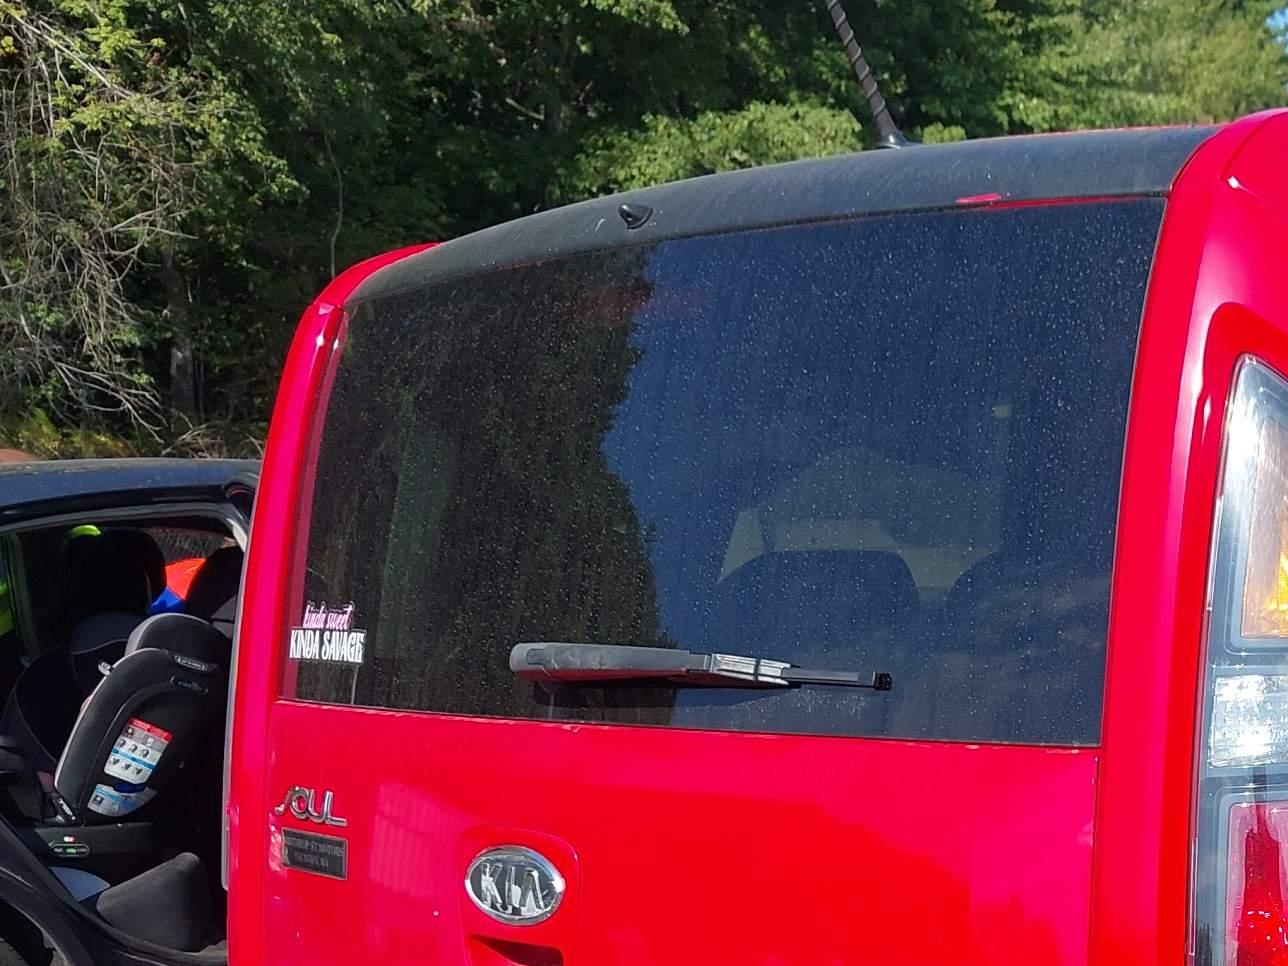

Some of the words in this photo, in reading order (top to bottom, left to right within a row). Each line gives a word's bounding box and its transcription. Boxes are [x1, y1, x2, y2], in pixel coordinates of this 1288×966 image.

[289, 629, 320, 660] KINDA
[321, 630, 365, 664] SAVAGE
[274, 785, 349, 827] SOUL
[481, 862, 548, 916] KIA
